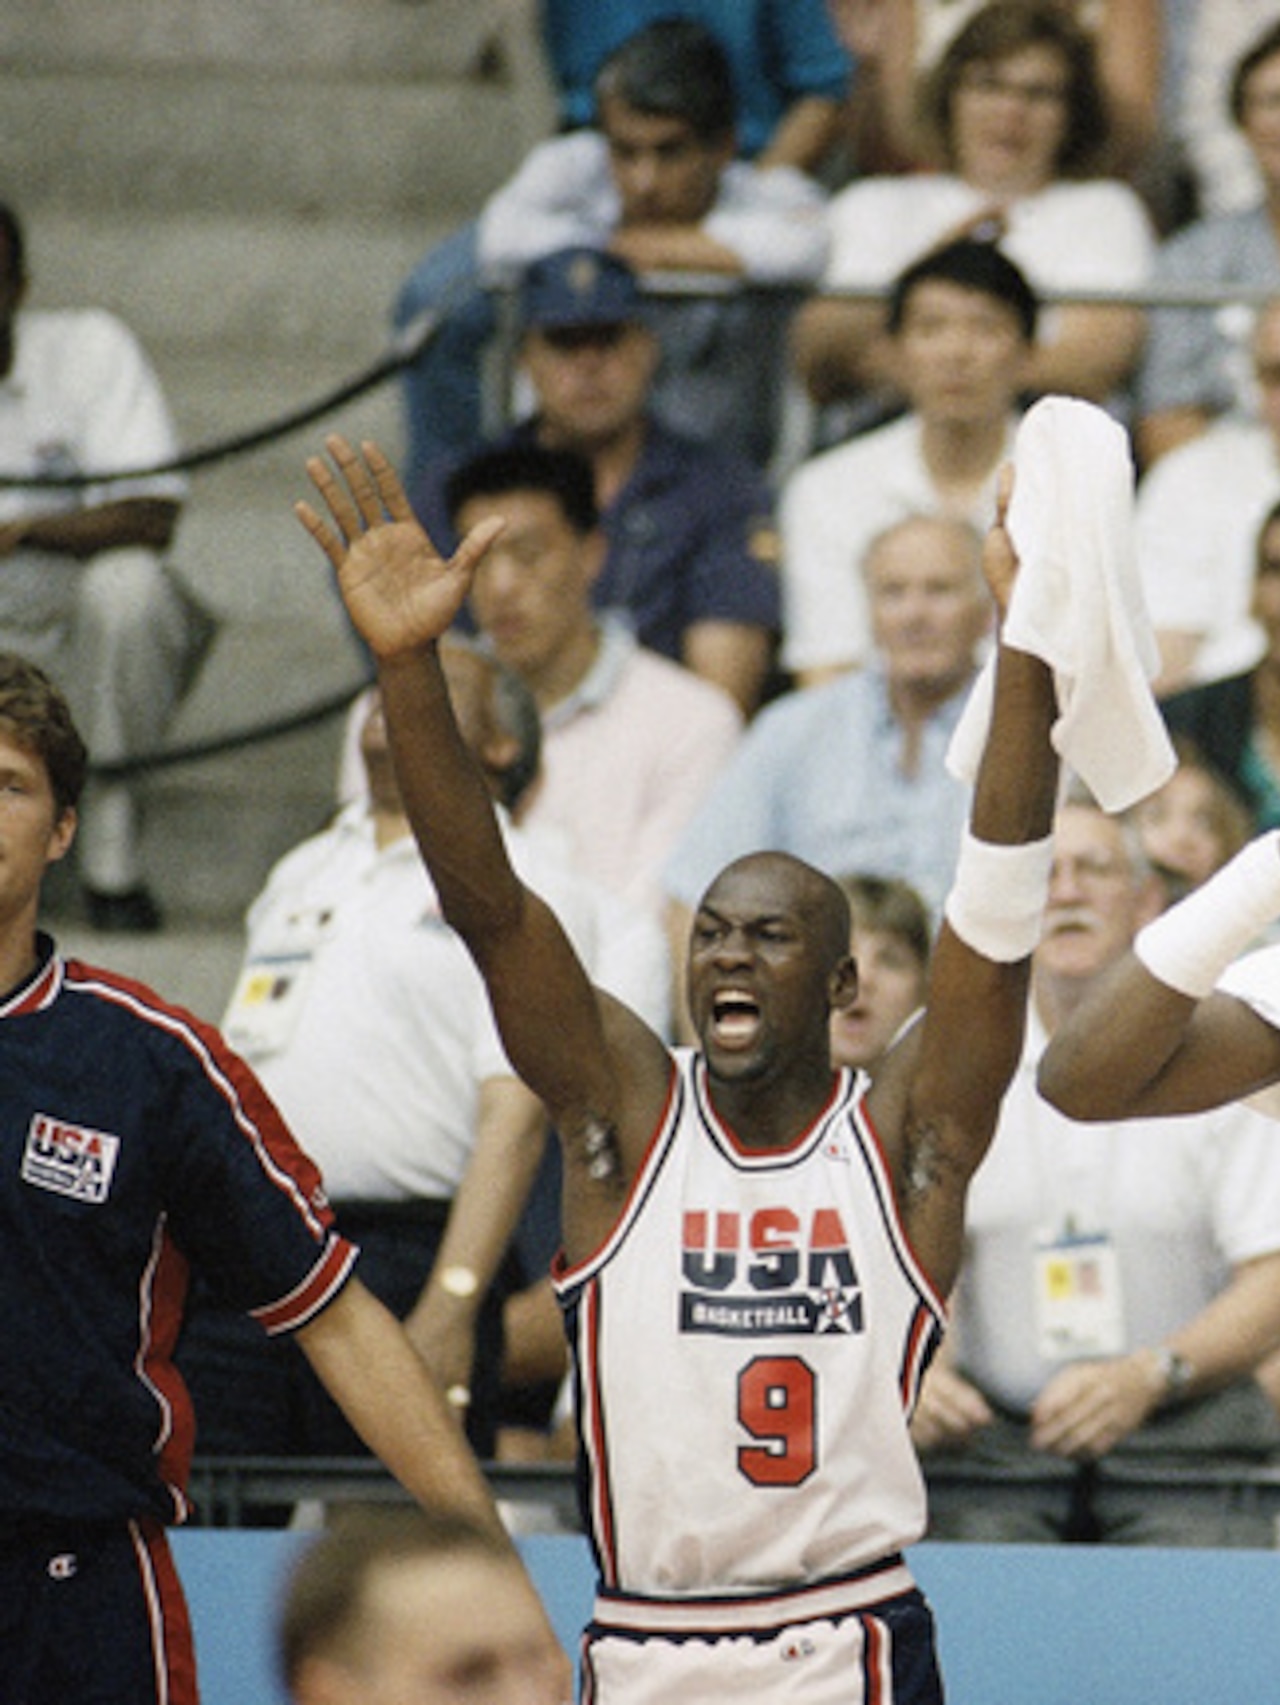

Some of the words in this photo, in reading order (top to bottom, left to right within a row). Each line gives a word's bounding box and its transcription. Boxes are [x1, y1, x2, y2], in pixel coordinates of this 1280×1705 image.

[33, 1121, 101, 1171] USA
[681, 1206, 858, 1291] USA
[692, 1302, 809, 1328] BASKETBALL
[736, 1354, 818, 1487] 9
